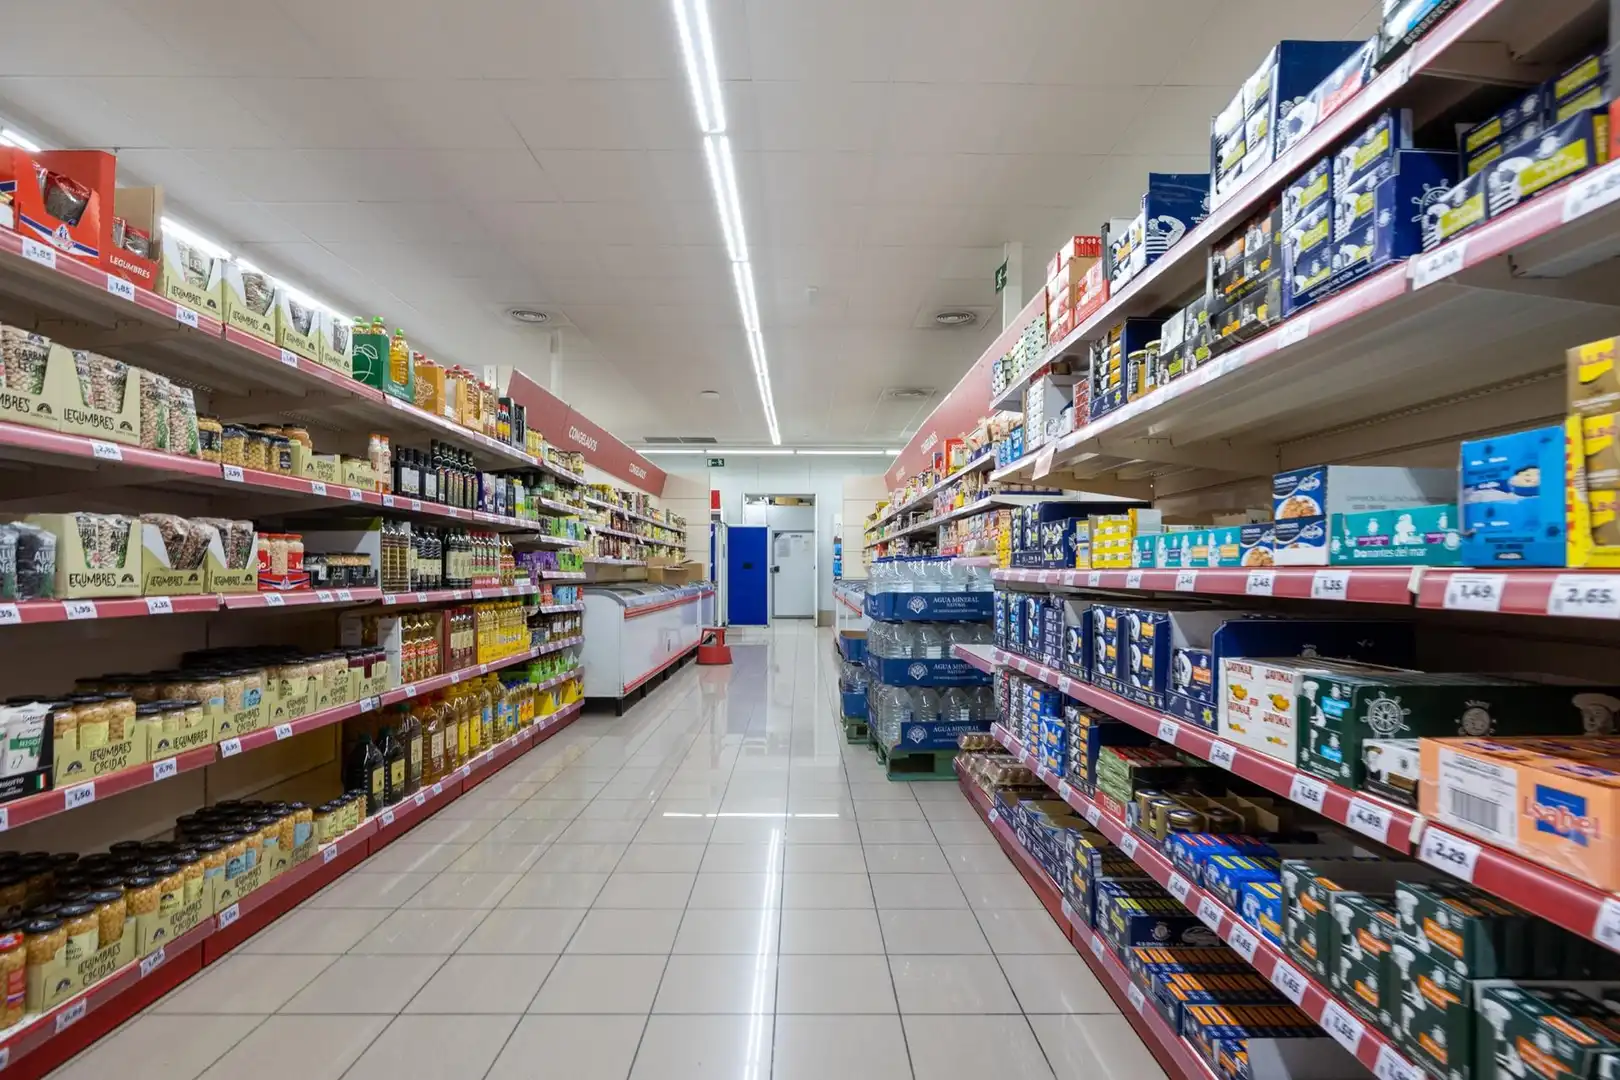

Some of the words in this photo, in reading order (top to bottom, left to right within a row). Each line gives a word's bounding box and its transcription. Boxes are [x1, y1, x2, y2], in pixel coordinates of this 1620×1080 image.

[110, 254, 151, 279] LEGUMBRES
[171, 285, 202, 307] LEGUMBRES
[63, 407, 115, 431] LEGUMBRES
[568, 425, 598, 452] CONGELADOS
[69, 573, 116, 588] EGUMBRES
[173, 730, 208, 750] LEGUMBRES
[90, 742, 132, 762] LEGUMBRES
[94, 756, 127, 775] COCIDAS
[1435, 843, 1467, 864] 2,29
[78, 943, 121, 973] LEGUMBRES
[82, 960, 116, 985] COCIDAS
